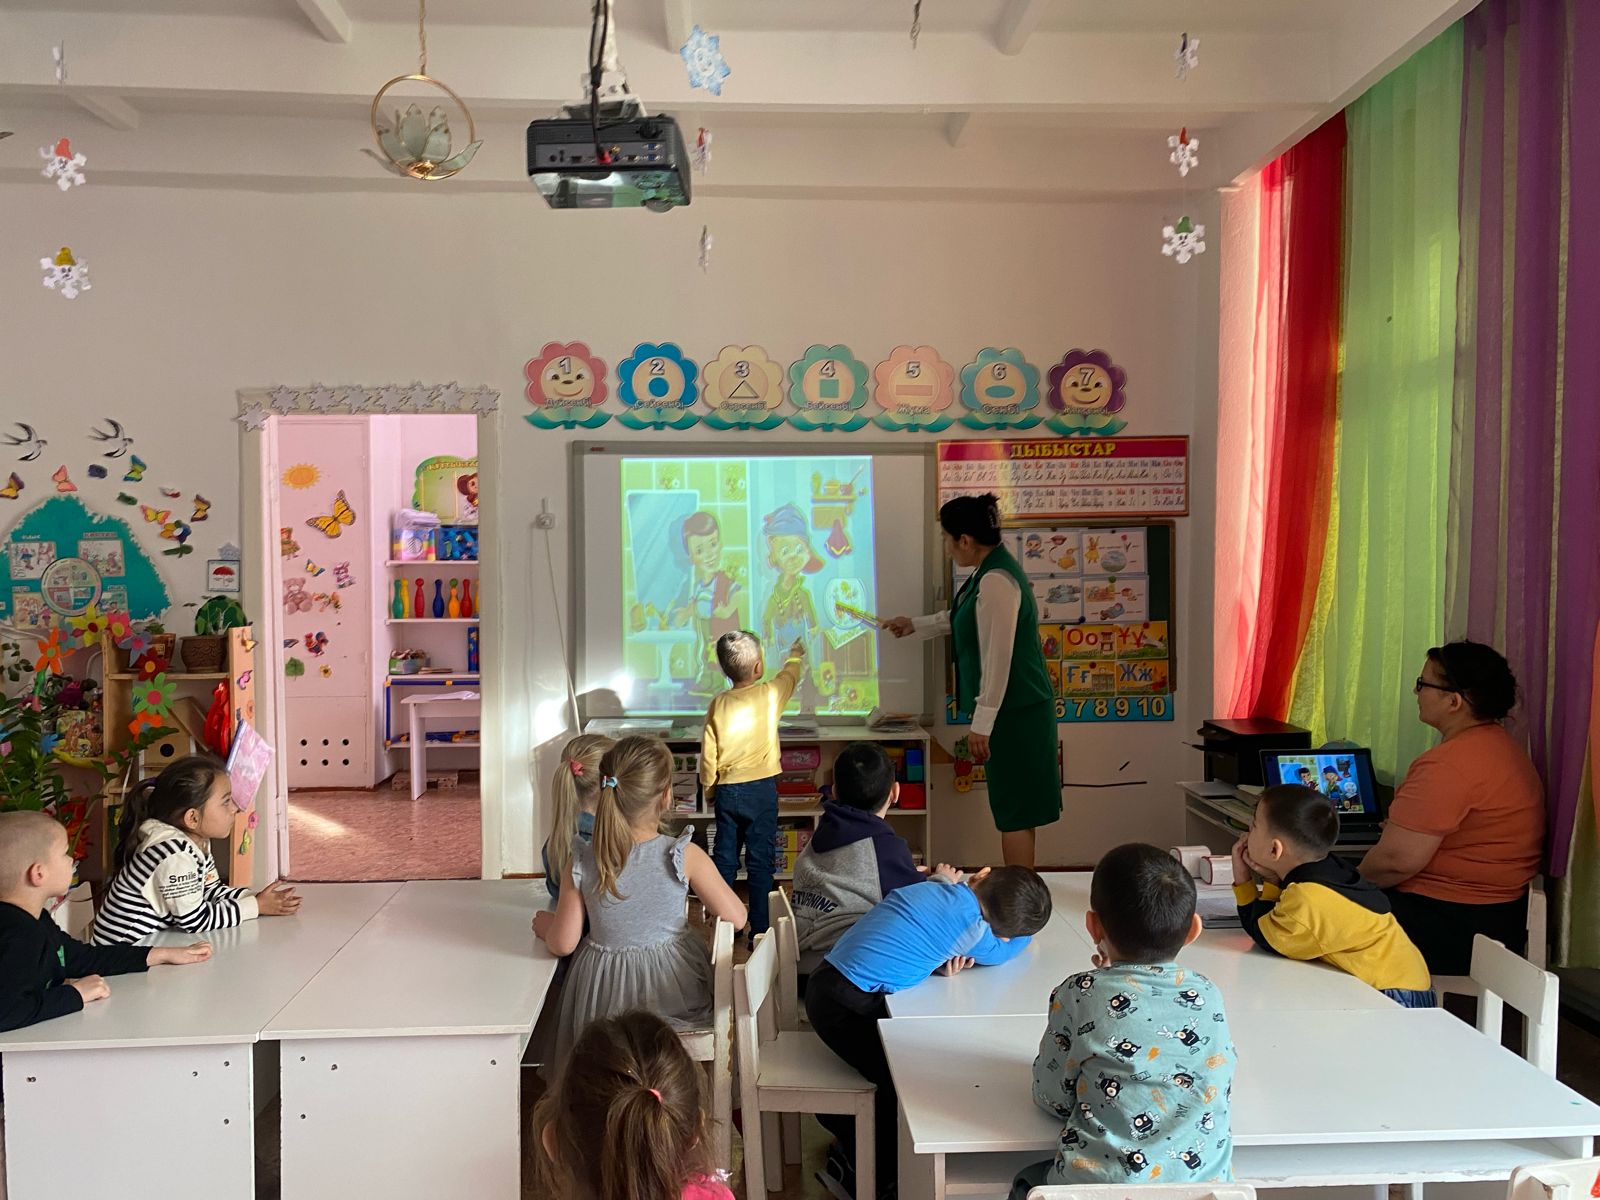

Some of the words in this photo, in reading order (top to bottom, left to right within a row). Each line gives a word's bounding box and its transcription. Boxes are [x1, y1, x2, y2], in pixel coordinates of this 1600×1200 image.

[558, 357, 572, 375] 1
[650, 359, 665, 375] 2
[735, 360, 750, 377] 3
[820, 360, 836, 377] 4
[906, 361, 921, 378] 5
[992, 363, 1007, 380] 6
[1079, 367, 1096, 385] 7
[1010, 442, 1116, 459] ДЫБЫСТАР
[946, 700, 958, 719] 1
[1072, 697, 1087, 718] 7
[1092, 696, 1108, 717] 8
[1114, 696, 1130, 717] 9
[1137, 696, 1165, 718] 10
[169, 872, 196, 883] Smile
